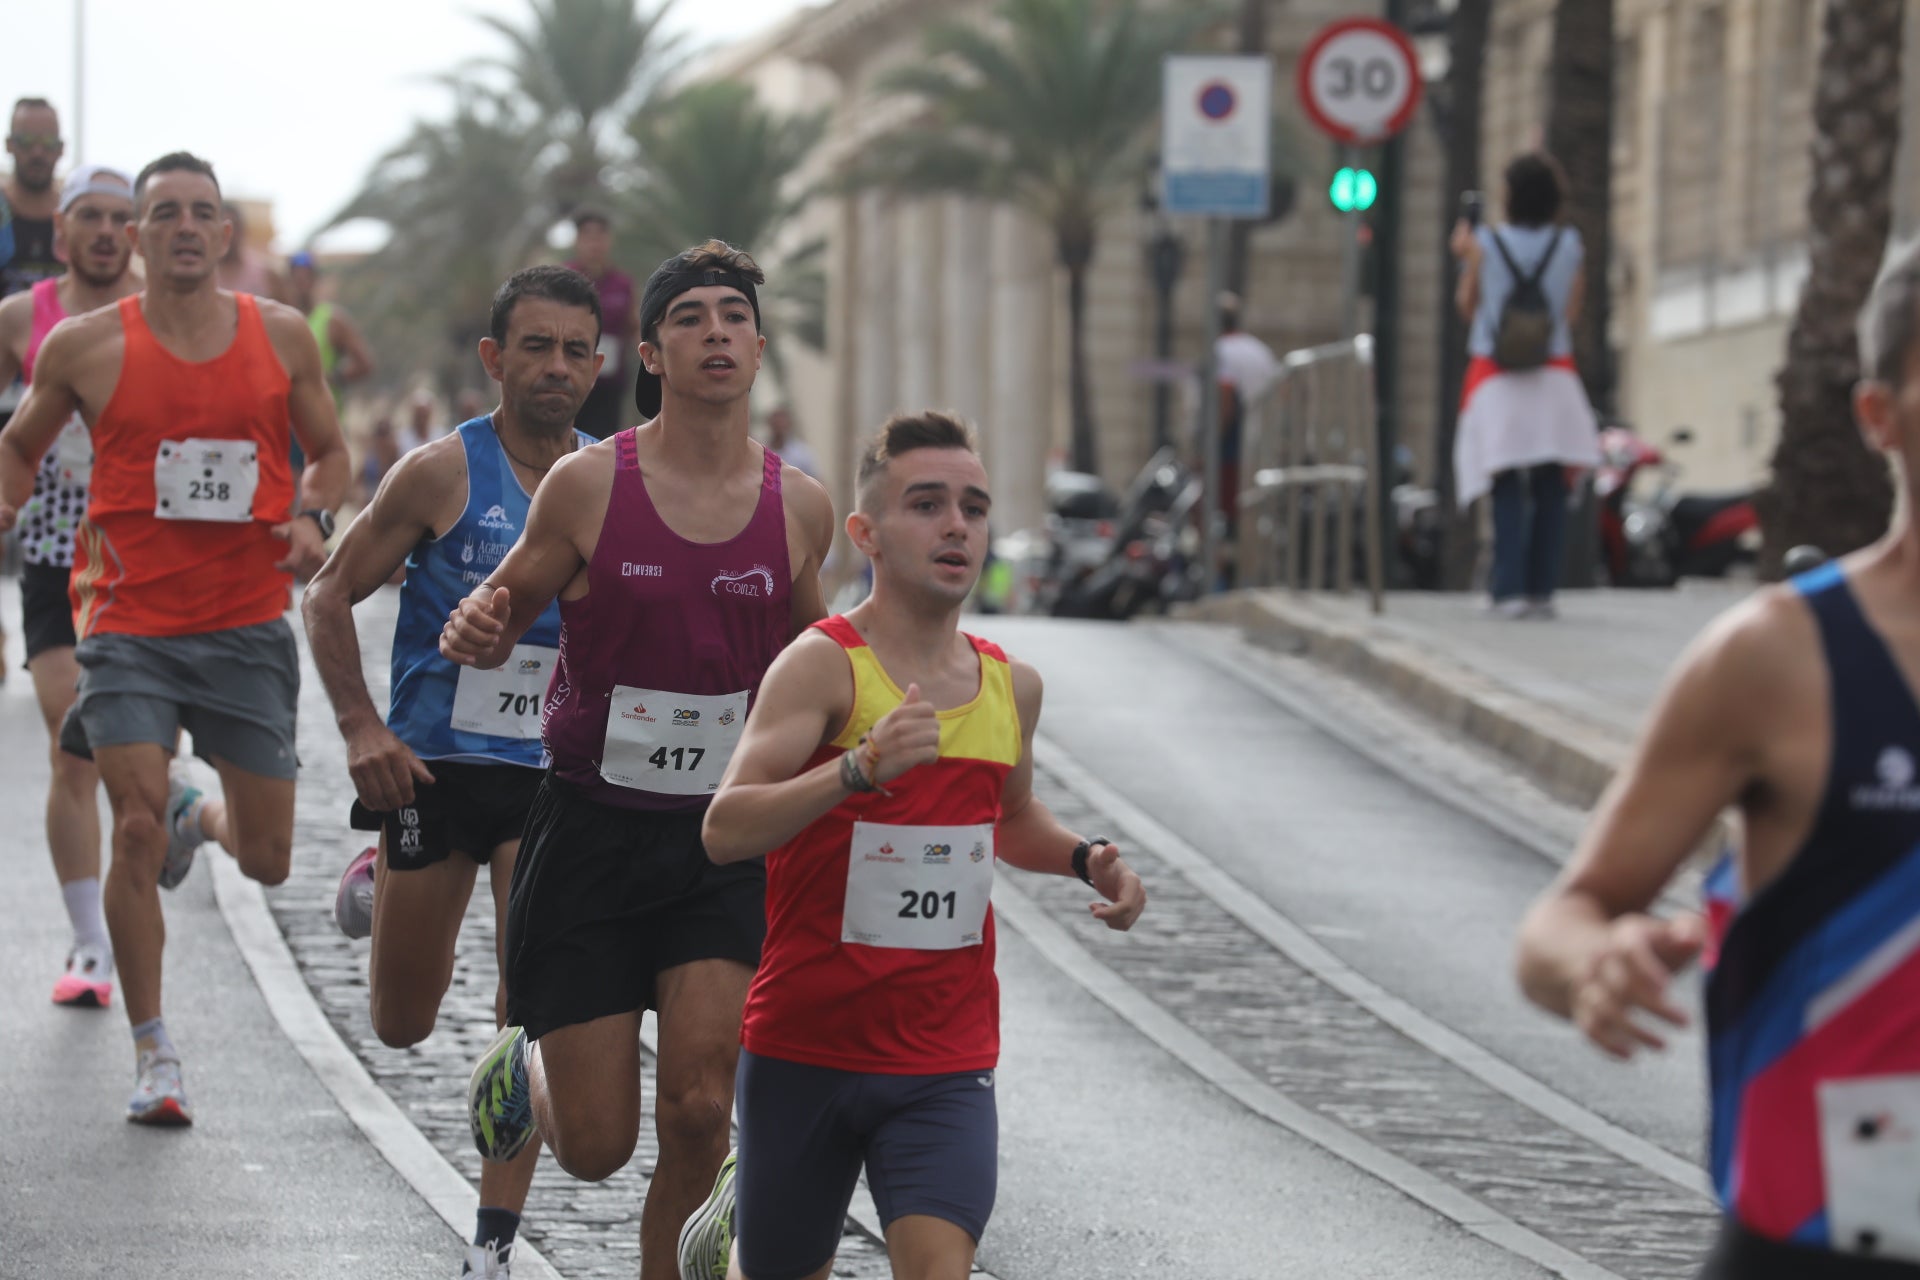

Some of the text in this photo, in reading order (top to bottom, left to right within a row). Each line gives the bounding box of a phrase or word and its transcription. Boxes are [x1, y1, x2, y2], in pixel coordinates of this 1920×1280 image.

[1325, 56, 1395, 100] 30
[189, 481, 230, 502] 258
[498, 692, 540, 716] 701
[673, 708, 701, 720] 200
[621, 711, 657, 724] Santander
[648, 746, 706, 771] 417
[864, 853, 906, 863] Santander
[923, 844, 952, 856] 200
[898, 890, 956, 919] 201
